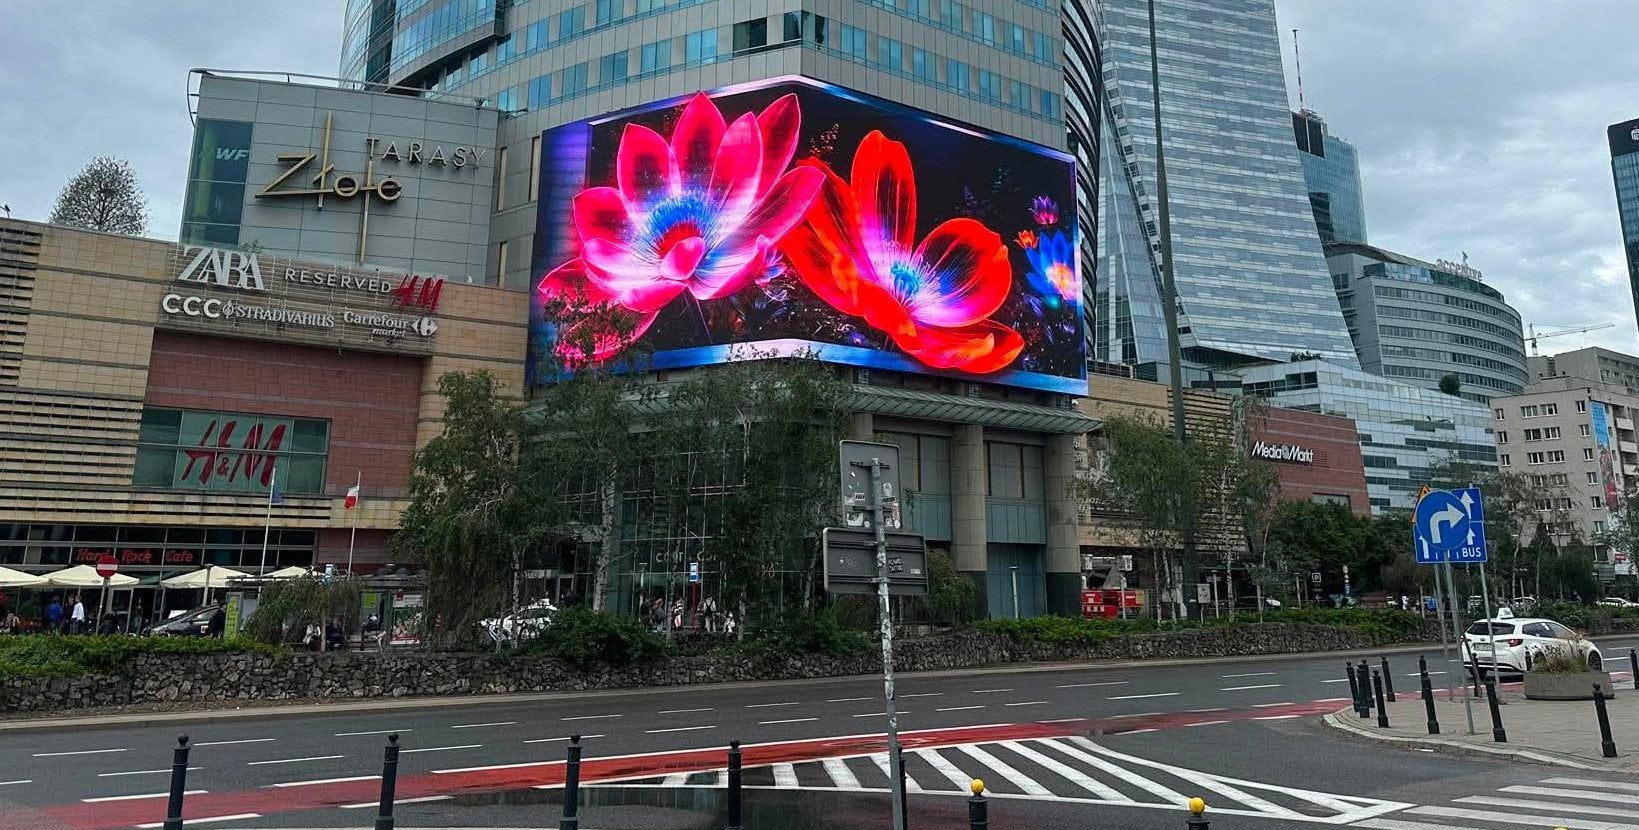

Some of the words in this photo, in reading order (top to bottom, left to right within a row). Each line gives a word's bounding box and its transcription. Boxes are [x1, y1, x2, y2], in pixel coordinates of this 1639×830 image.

[367, 137, 487, 169] TARASY
[178, 245, 265, 290] ZARA
[285, 267, 392, 293] RESERVED
[162, 294, 221, 318] CCC
[235, 304, 335, 328] STRADIVARIUS
[343, 310, 409, 330] Carrefour
[372, 327, 406, 338] market
[181, 420, 287, 487] H&M
[76, 548, 111, 562] Har
[165, 550, 193, 562] Cafe
[1461, 547, 1481, 558] BUS
